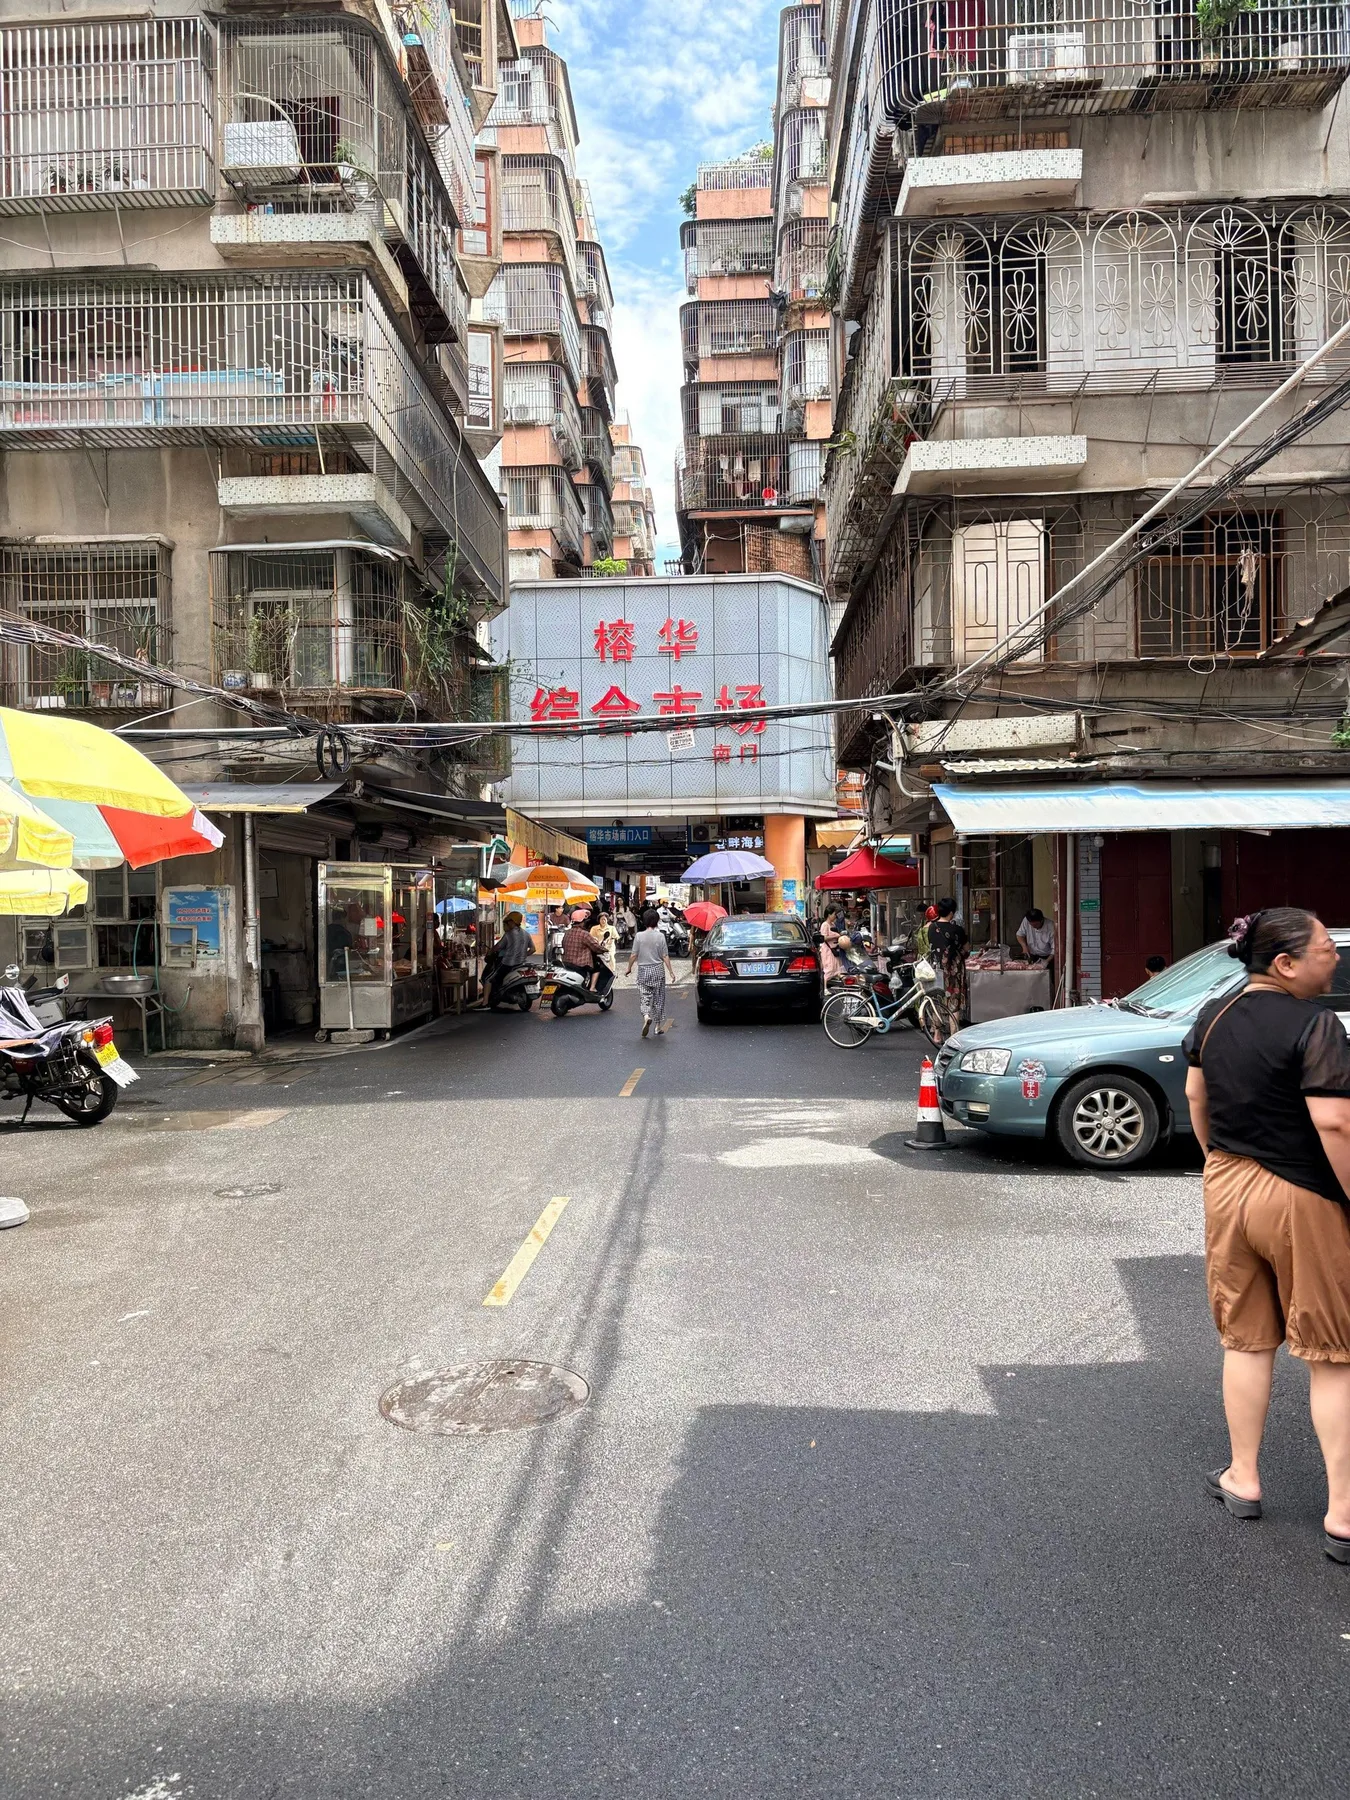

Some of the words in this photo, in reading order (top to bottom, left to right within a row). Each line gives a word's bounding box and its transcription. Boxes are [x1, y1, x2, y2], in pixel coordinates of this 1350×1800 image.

[593, 617, 699, 662] 榕华
[530, 684, 767, 737] 综合市场
[711, 743, 758, 765] 南门
[589, 829, 649, 842] 榕华市场南门入口
[1026, 1081, 1036, 1098] 平安
